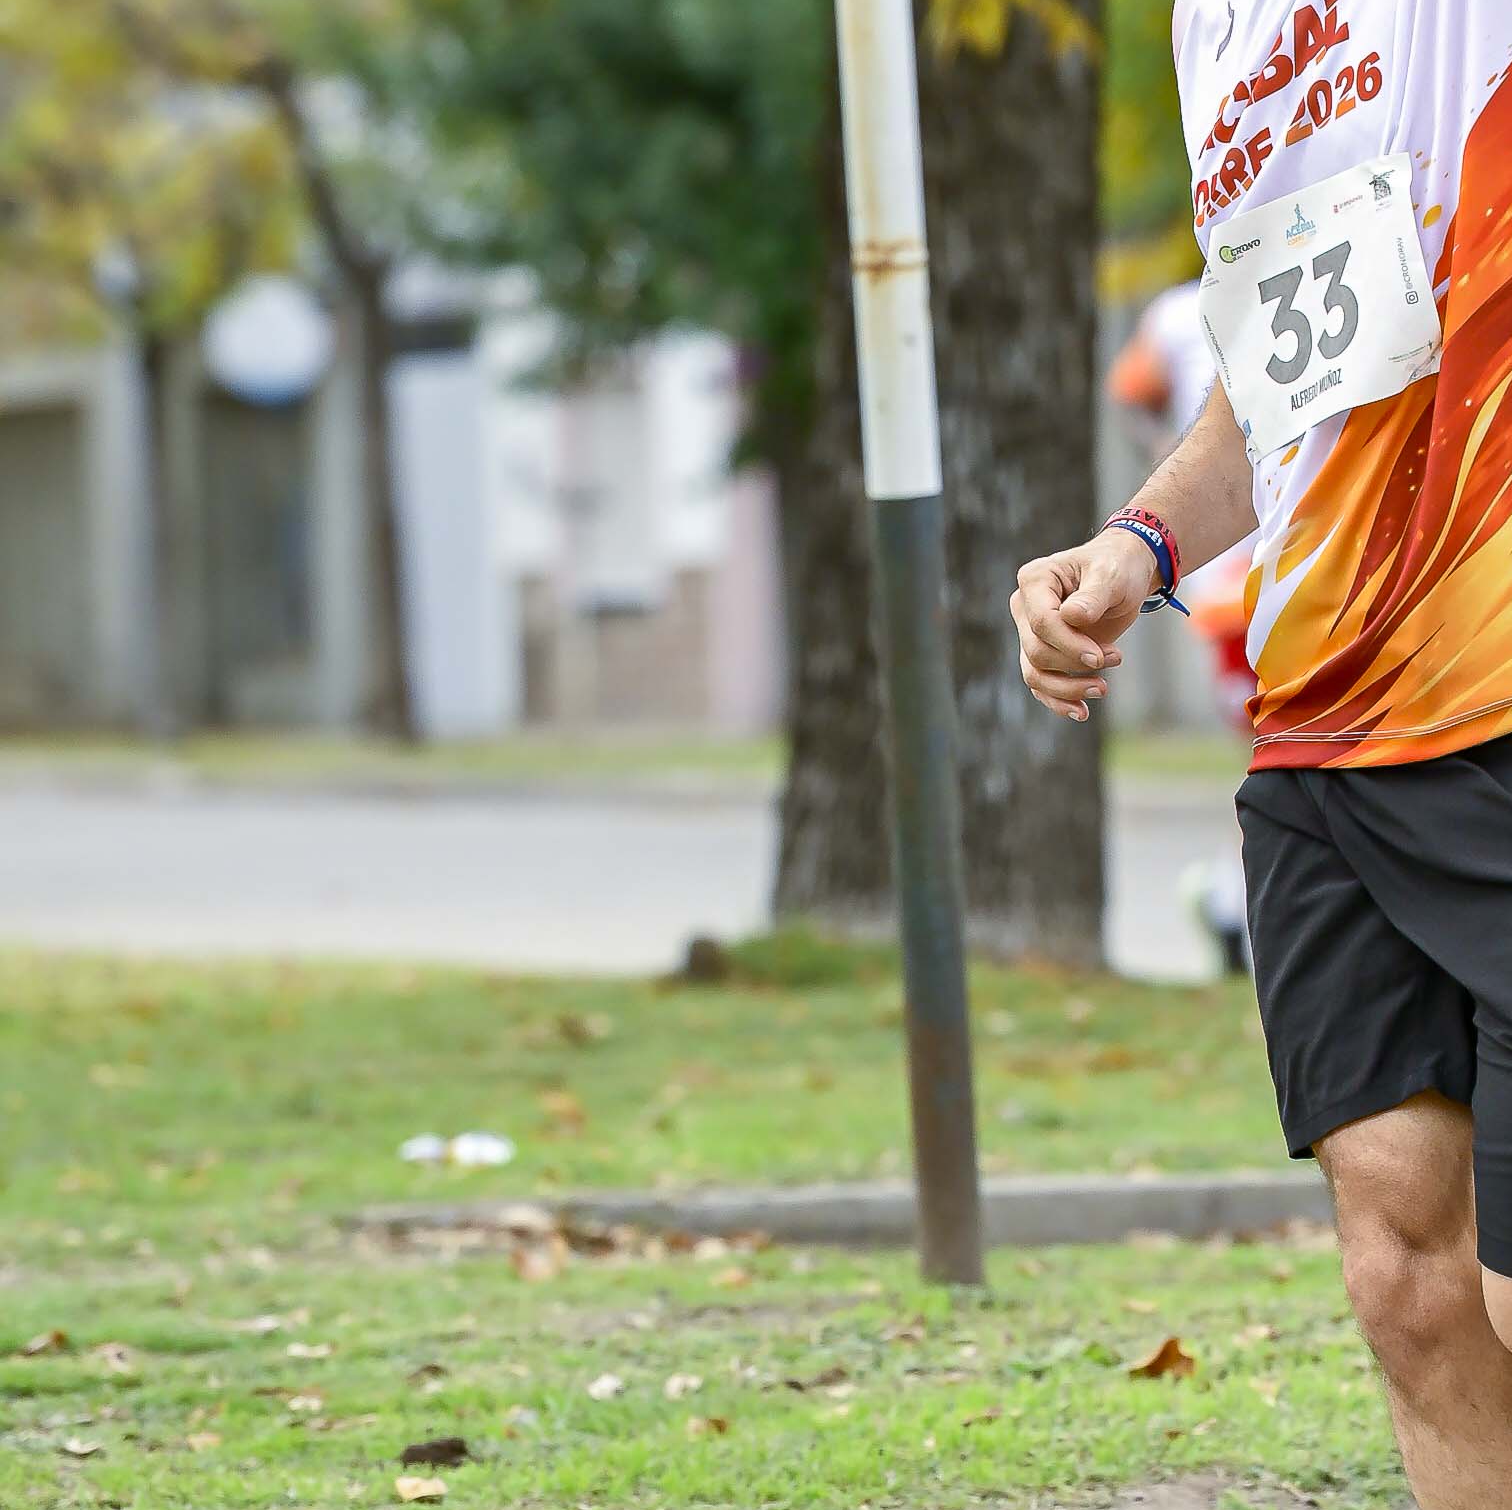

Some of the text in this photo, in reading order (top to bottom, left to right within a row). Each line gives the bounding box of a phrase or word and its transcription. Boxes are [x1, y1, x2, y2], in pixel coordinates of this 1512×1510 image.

[1286, 51, 1382, 148] 2026
[1258, 240, 1359, 385] 33
[1290, 368, 1343, 412] ALFREDO MUÑOZ
